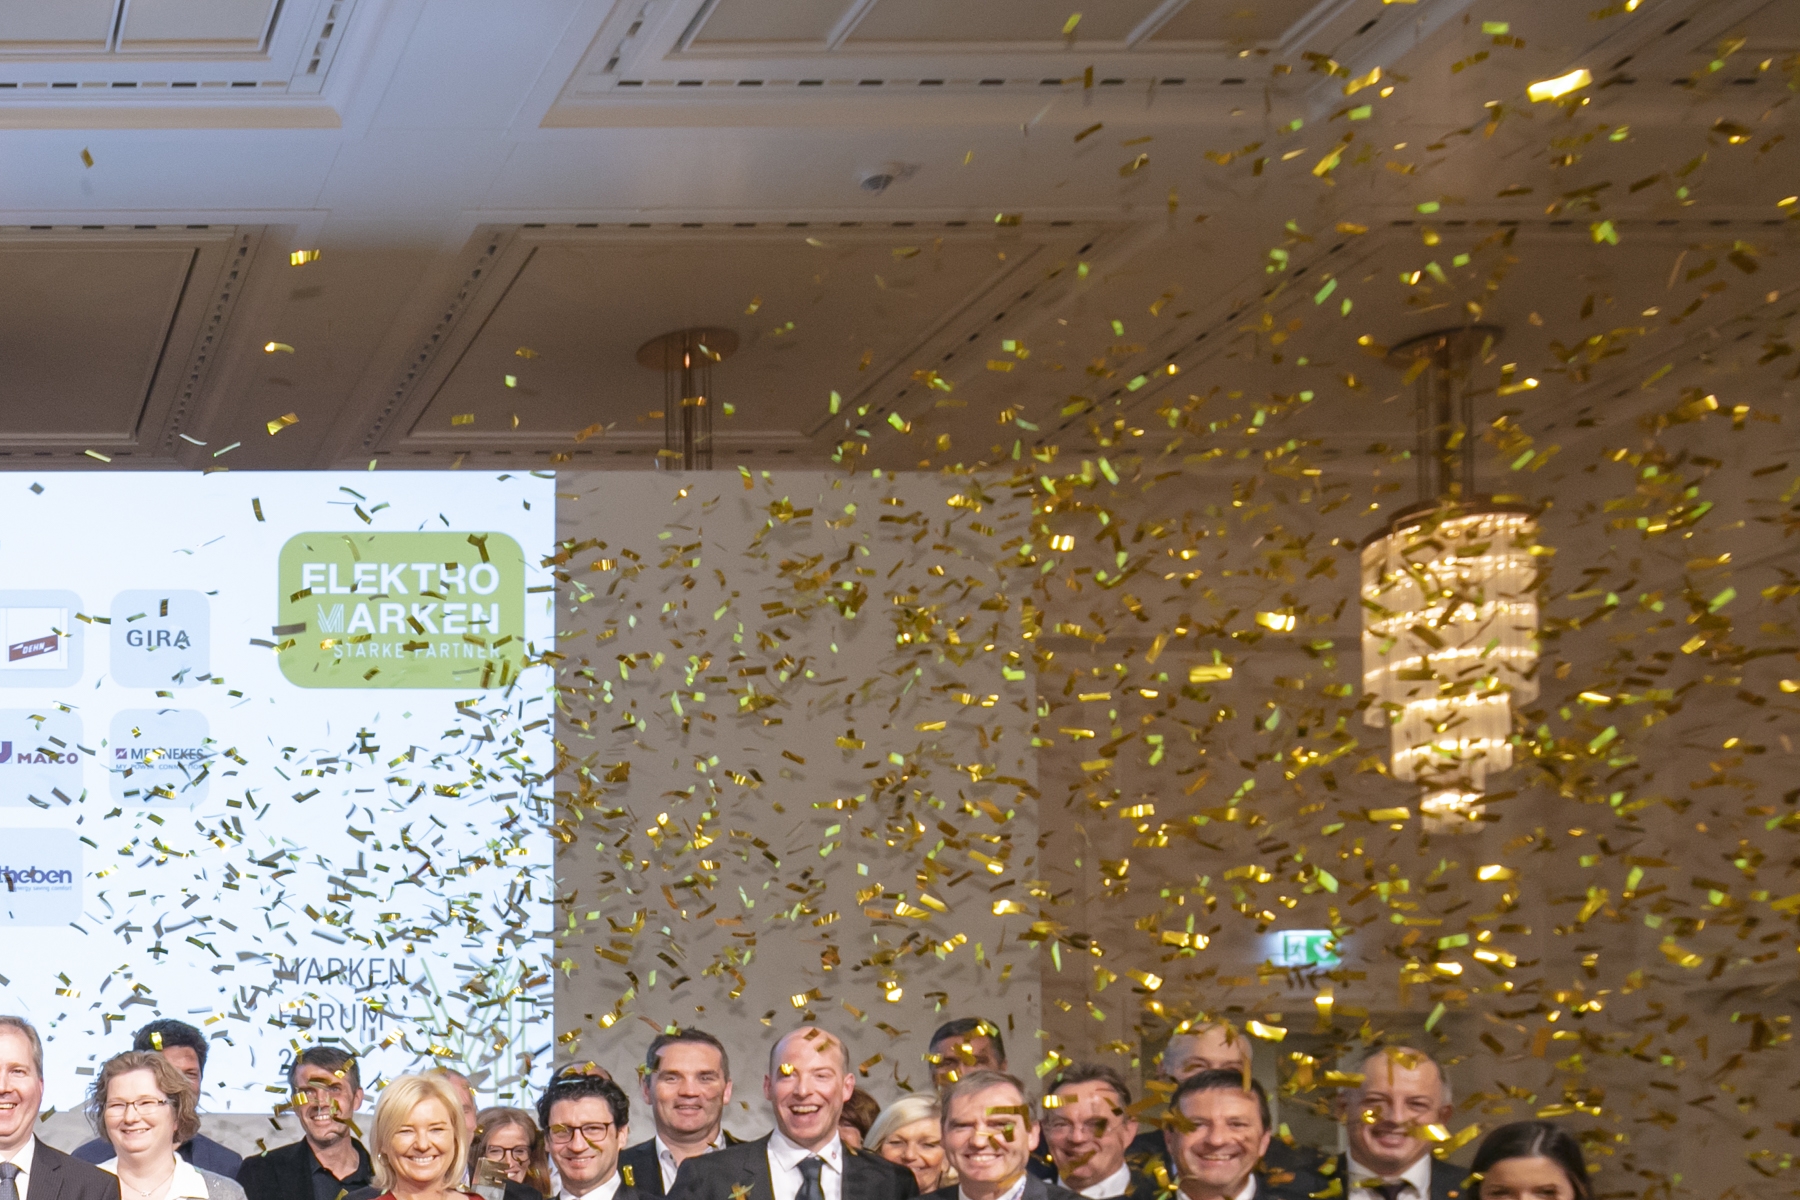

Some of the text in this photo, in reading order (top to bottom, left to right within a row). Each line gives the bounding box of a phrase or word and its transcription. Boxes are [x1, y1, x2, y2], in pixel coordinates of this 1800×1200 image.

[301, 562, 500, 595] ELEKTRO
[316, 602, 500, 635] MARKEN
[126, 629, 192, 647] GIRA
[22, 641, 46, 655] DEHN
[333, 642, 405, 659] STARKE
[130, 747, 205, 760] MENEKES
[279, 957, 406, 985] MARKEN
